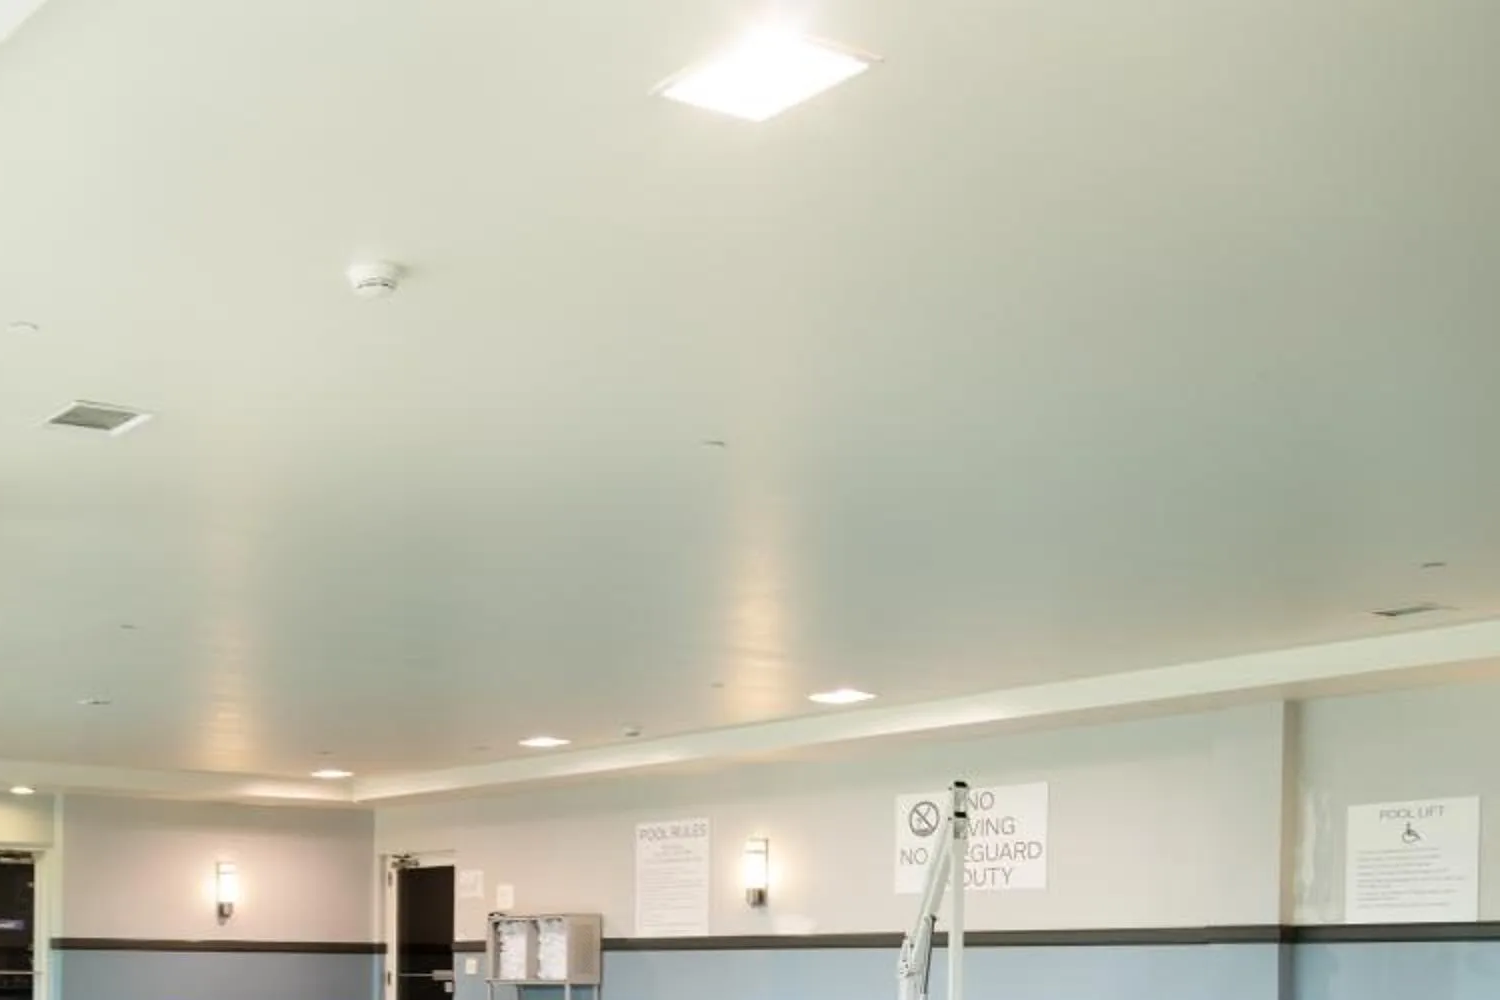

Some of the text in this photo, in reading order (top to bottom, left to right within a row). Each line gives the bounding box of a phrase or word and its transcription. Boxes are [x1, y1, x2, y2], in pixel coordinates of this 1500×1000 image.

[967, 791, 995, 811] NO
[1380, 804, 1445, 820] POOL LIFT
[967, 816, 1016, 836] VING
[900, 841, 1043, 865] NO GUARD
